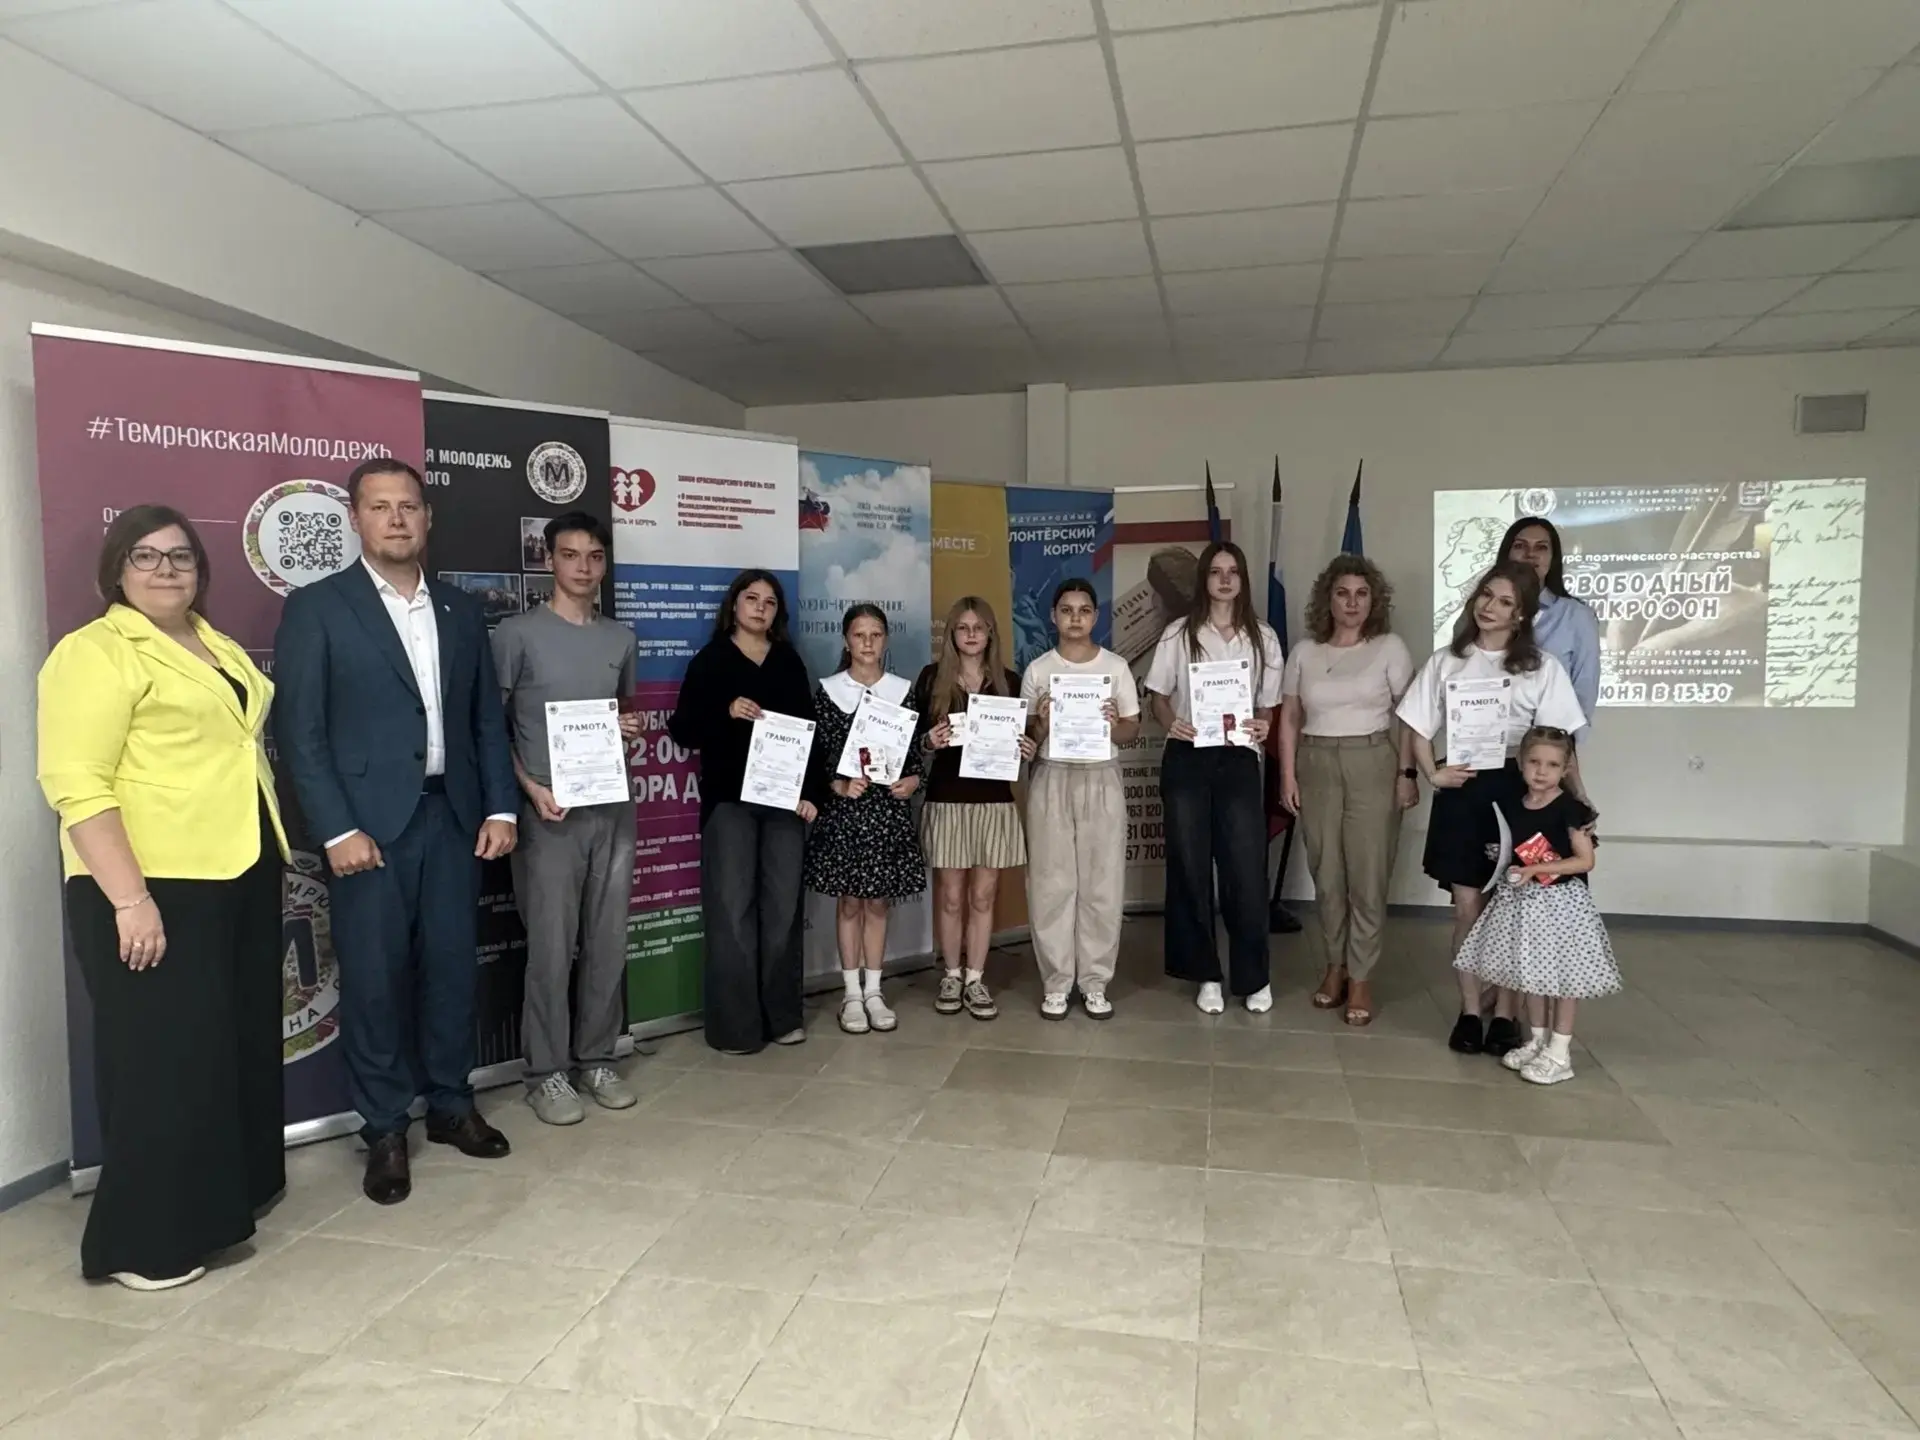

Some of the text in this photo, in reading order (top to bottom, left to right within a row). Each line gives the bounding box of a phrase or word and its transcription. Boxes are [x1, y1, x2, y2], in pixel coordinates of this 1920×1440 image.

[439, 449, 512, 469] МОЛОДЕЖЬ
[1008, 526, 1096, 543] ЛОНТЁРСКИЙ
[1043, 542, 1096, 557] КОРПУС
[1585, 551, 1678, 564] поэтического
[1680, 550, 1761, 561] мастерства
[1063, 691, 1101, 700] ГРАМОТА
[1654, 684, 1668, 700] В
[1460, 697, 1500, 707] ГРАМОТА
[868, 714, 904, 733] ГРАМОТА
[979, 713, 1016, 724] ГРАМОТА
[562, 722, 608, 732] ГРАМОТА
[764, 731, 801, 745] ГРАМОТА
